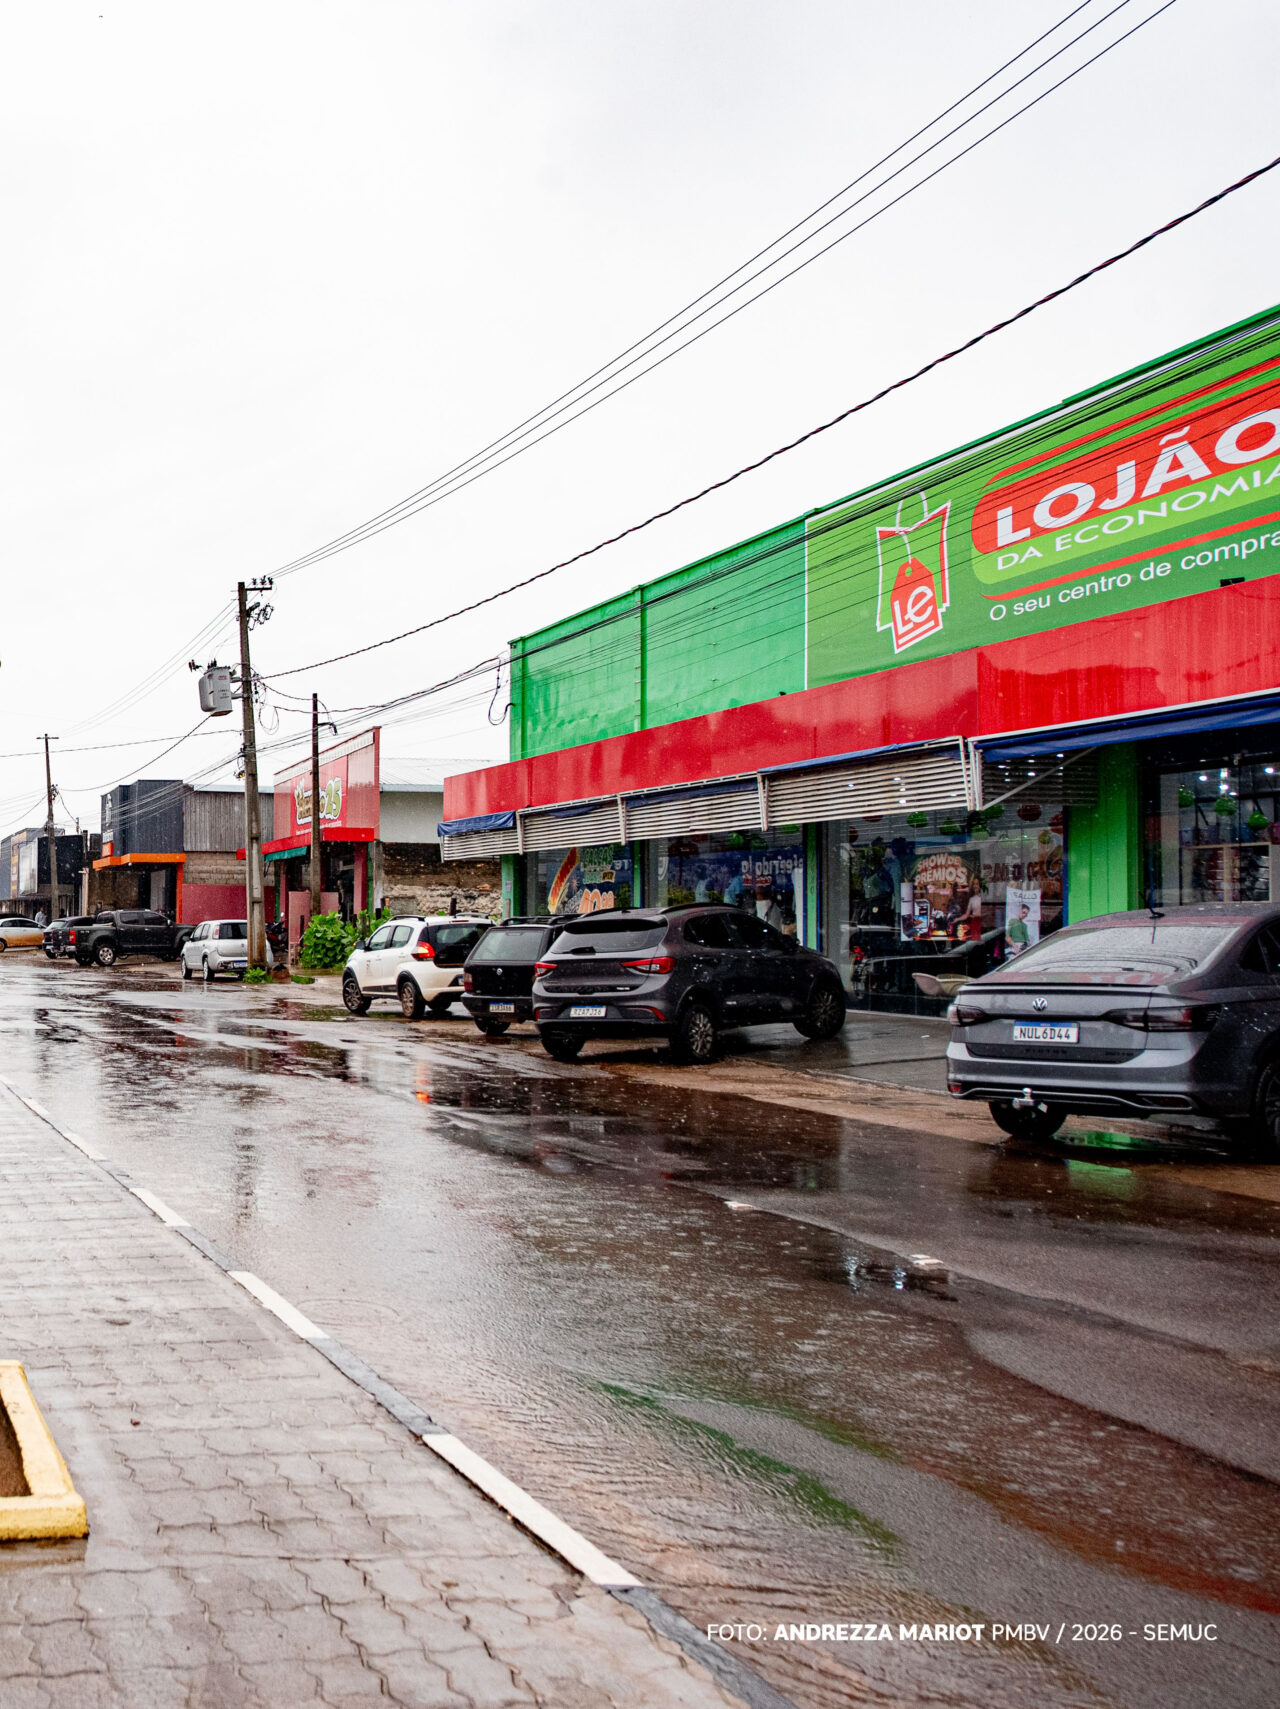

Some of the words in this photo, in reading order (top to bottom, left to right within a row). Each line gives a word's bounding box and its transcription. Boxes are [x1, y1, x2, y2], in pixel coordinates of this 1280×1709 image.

[996, 408, 1280, 548] LOJÃO
[997, 546, 1044, 571] DA
[989, 604, 1007, 621] O
[1013, 594, 1051, 616] seu
[1058, 573, 1132, 604] centro
[1140, 561, 1172, 582] de
[917, 852, 947, 870] SHOW
[948, 855, 962, 867] DE
[1019, 1026, 1071, 1040] NUL6D44
